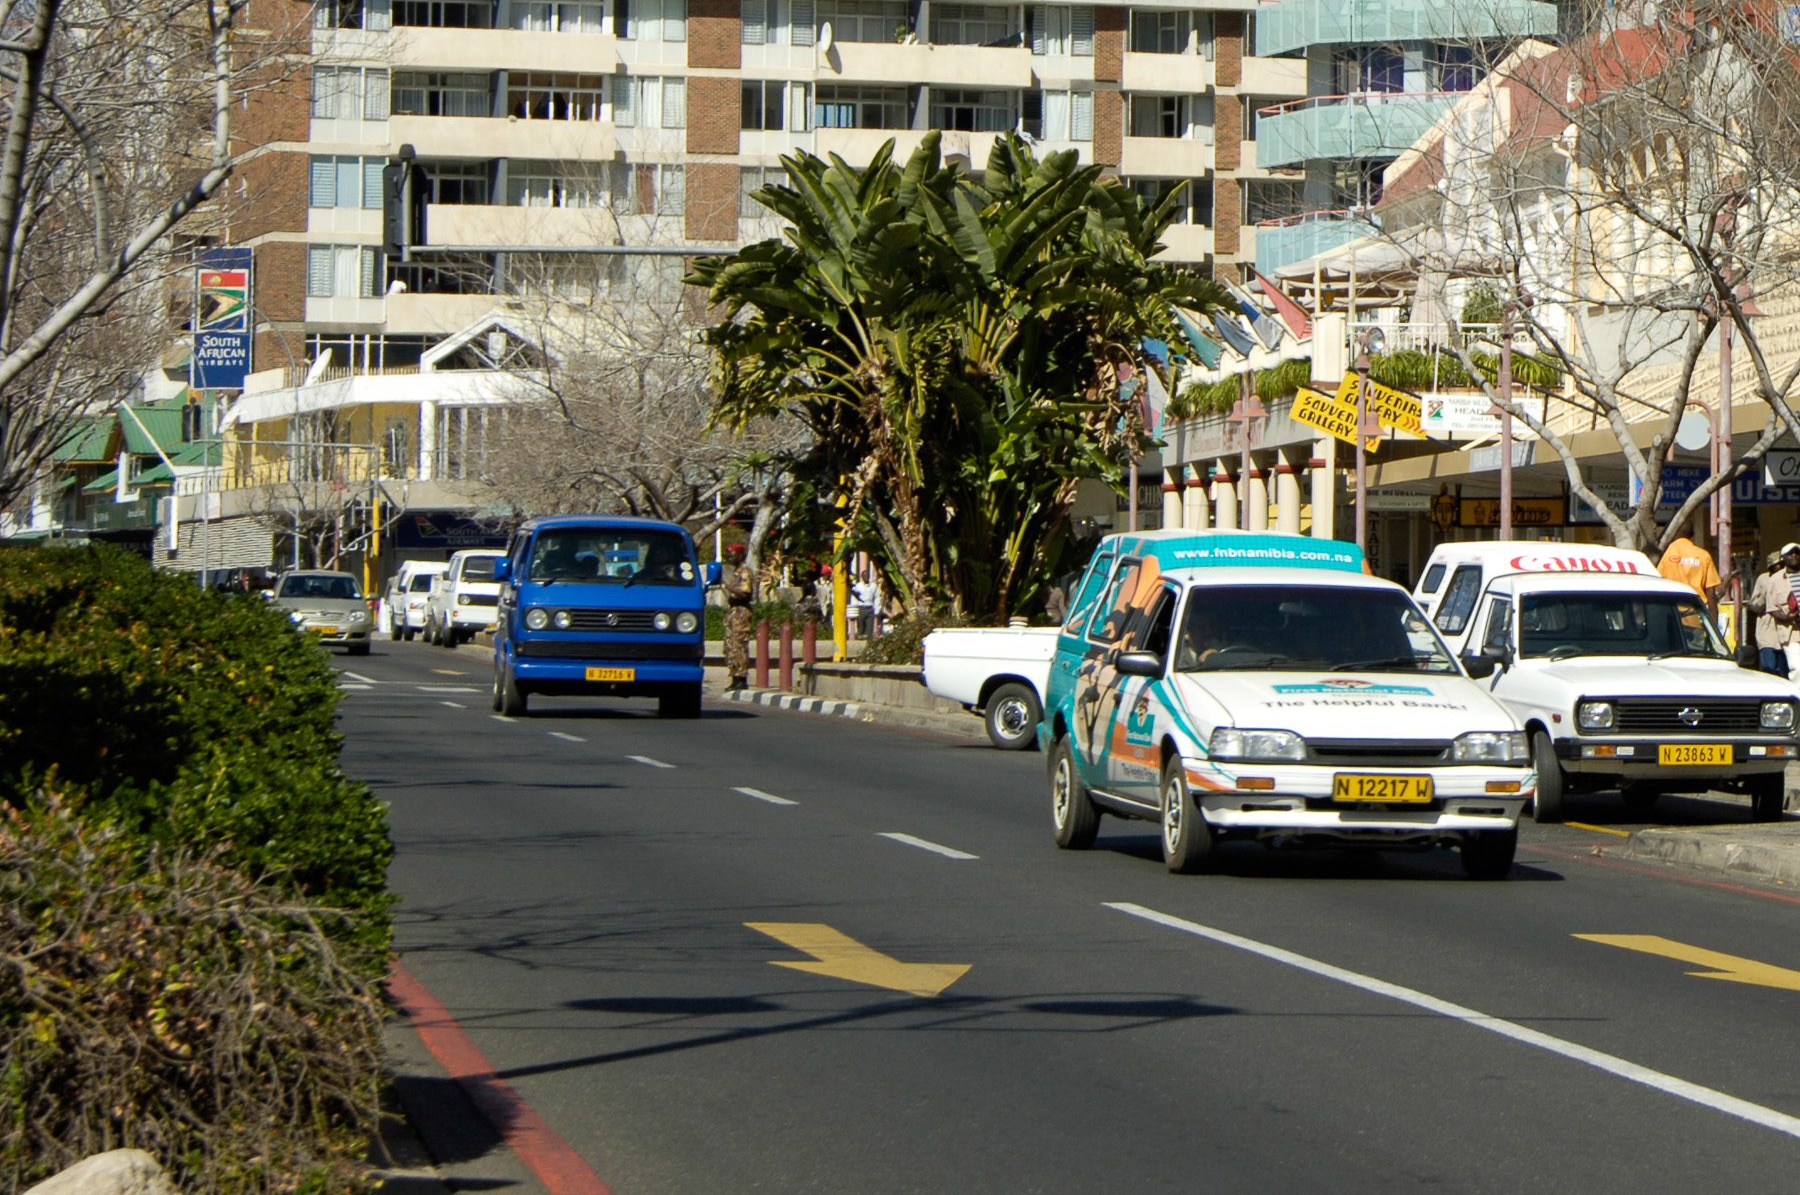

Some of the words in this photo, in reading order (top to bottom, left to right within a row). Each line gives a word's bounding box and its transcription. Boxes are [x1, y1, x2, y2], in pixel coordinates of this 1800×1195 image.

[202, 335, 241, 347] SOUTH
[198, 347, 246, 360] AFRICAN
[1453, 406, 1485, 415] HEAD
[1173, 547, 1353, 563] www.fnbnamibia.com.na
[1509, 555, 1639, 574] Canon
[1264, 700, 1305, 708] The
[1312, 699, 1395, 708] Helpful
[1663, 747, 1671, 762] N
[1675, 747, 1714, 762] 23863
[1719, 747, 1726, 761] W
[1337, 778, 1350, 796] N
[1357, 779, 1409, 797] 12217
[1416, 780, 1430, 798] W
